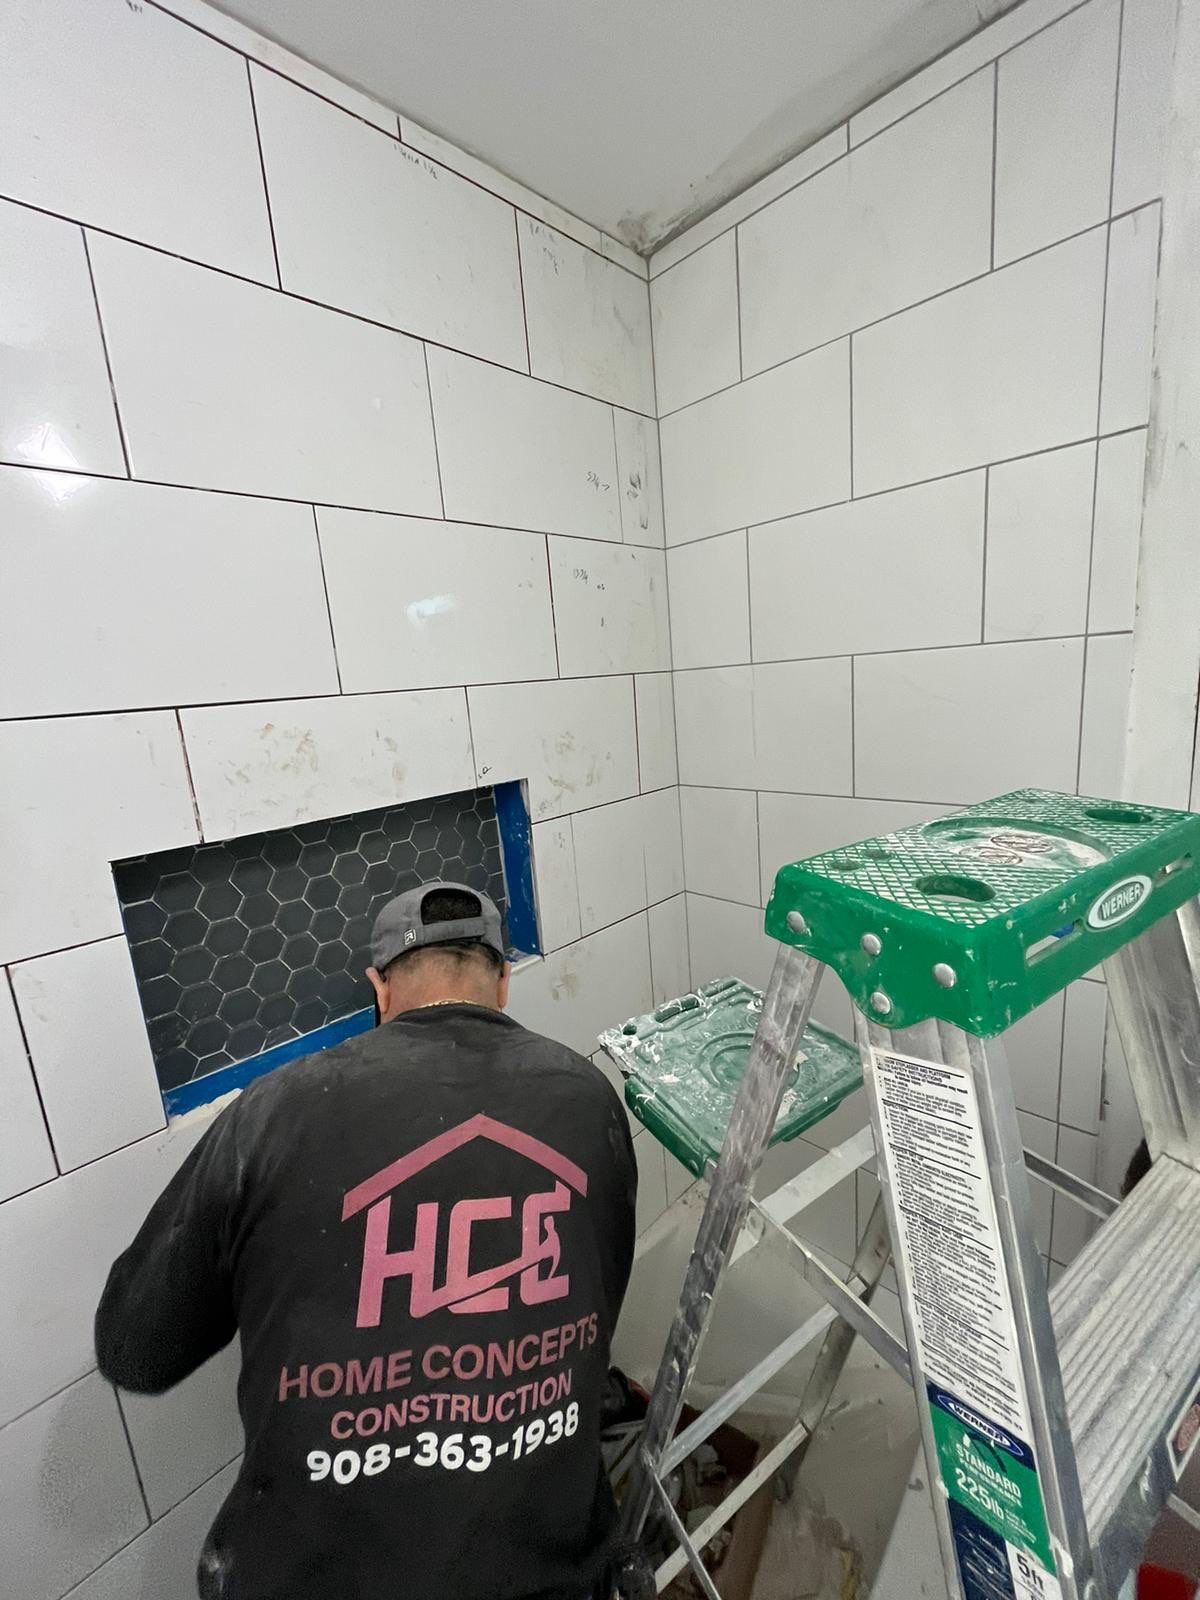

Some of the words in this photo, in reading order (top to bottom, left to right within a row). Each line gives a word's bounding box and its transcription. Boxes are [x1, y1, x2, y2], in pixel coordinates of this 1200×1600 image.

[1101, 883, 1140, 919] WERNER
[278, 1350, 412, 1402] HOME
[422, 1312, 598, 1383] CONCEPTS
[331, 1368, 572, 1440] CONSTRUCTION
[953, 1403, 1005, 1442] WERNER
[306, 1402, 579, 1485] 908-363-1938
[956, 1443, 1021, 1498] STANDARD
